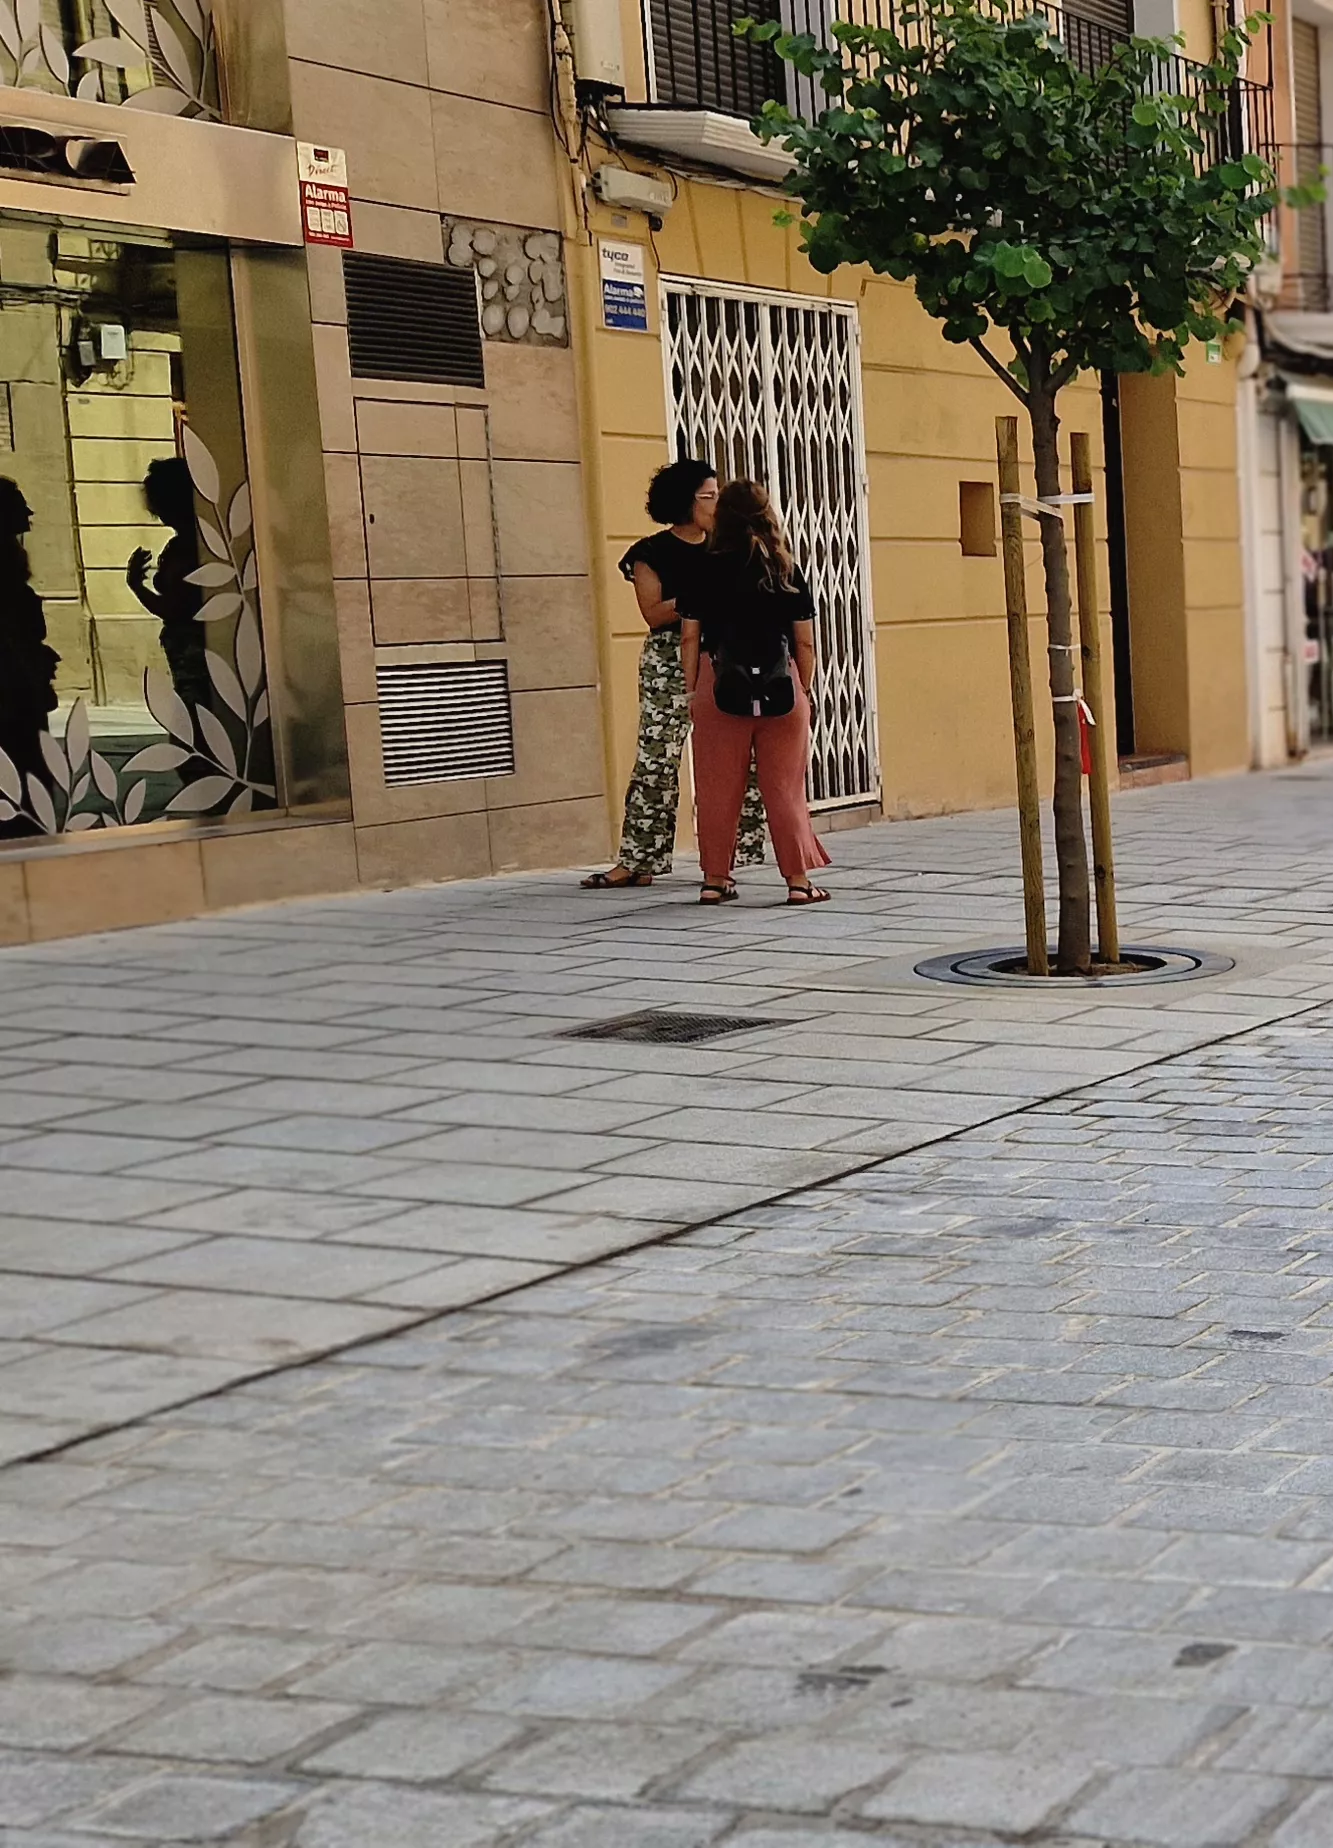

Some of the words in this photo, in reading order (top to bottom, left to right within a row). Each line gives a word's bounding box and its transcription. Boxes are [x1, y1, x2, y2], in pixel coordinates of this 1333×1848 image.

[305, 184, 346, 203] Alarma
[602, 248, 628, 261] tyco
[605, 284, 633, 298] Alarma
